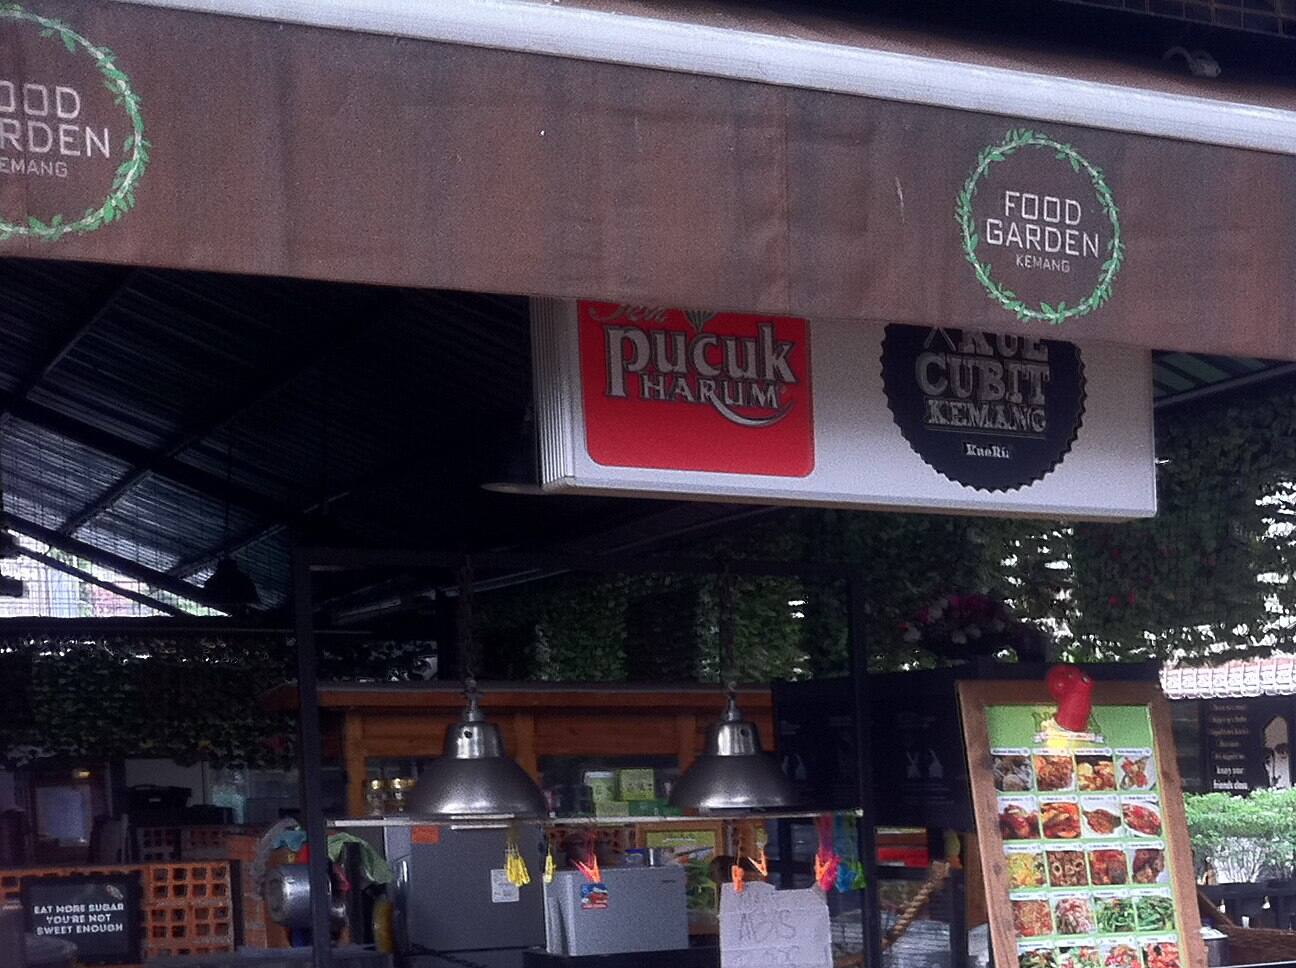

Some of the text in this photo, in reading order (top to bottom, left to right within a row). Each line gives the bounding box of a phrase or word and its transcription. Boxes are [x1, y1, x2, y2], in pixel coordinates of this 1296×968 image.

[1005, 190, 1082, 226] FOOD
[986, 218, 1099, 258] GARDEN
[1015, 253, 1070, 273] KEMANG
[604, 322, 797, 398] pucuk
[641, 373, 780, 411] HARUM
[914, 352, 1051, 407] CUBIT
[926, 399, 1048, 433] KEMANG
[34, 903, 124, 914] EAT MORE SUGAR
[88, 913, 111, 923] NOT
[37, 923, 123, 935] SWEET ENOUGH
